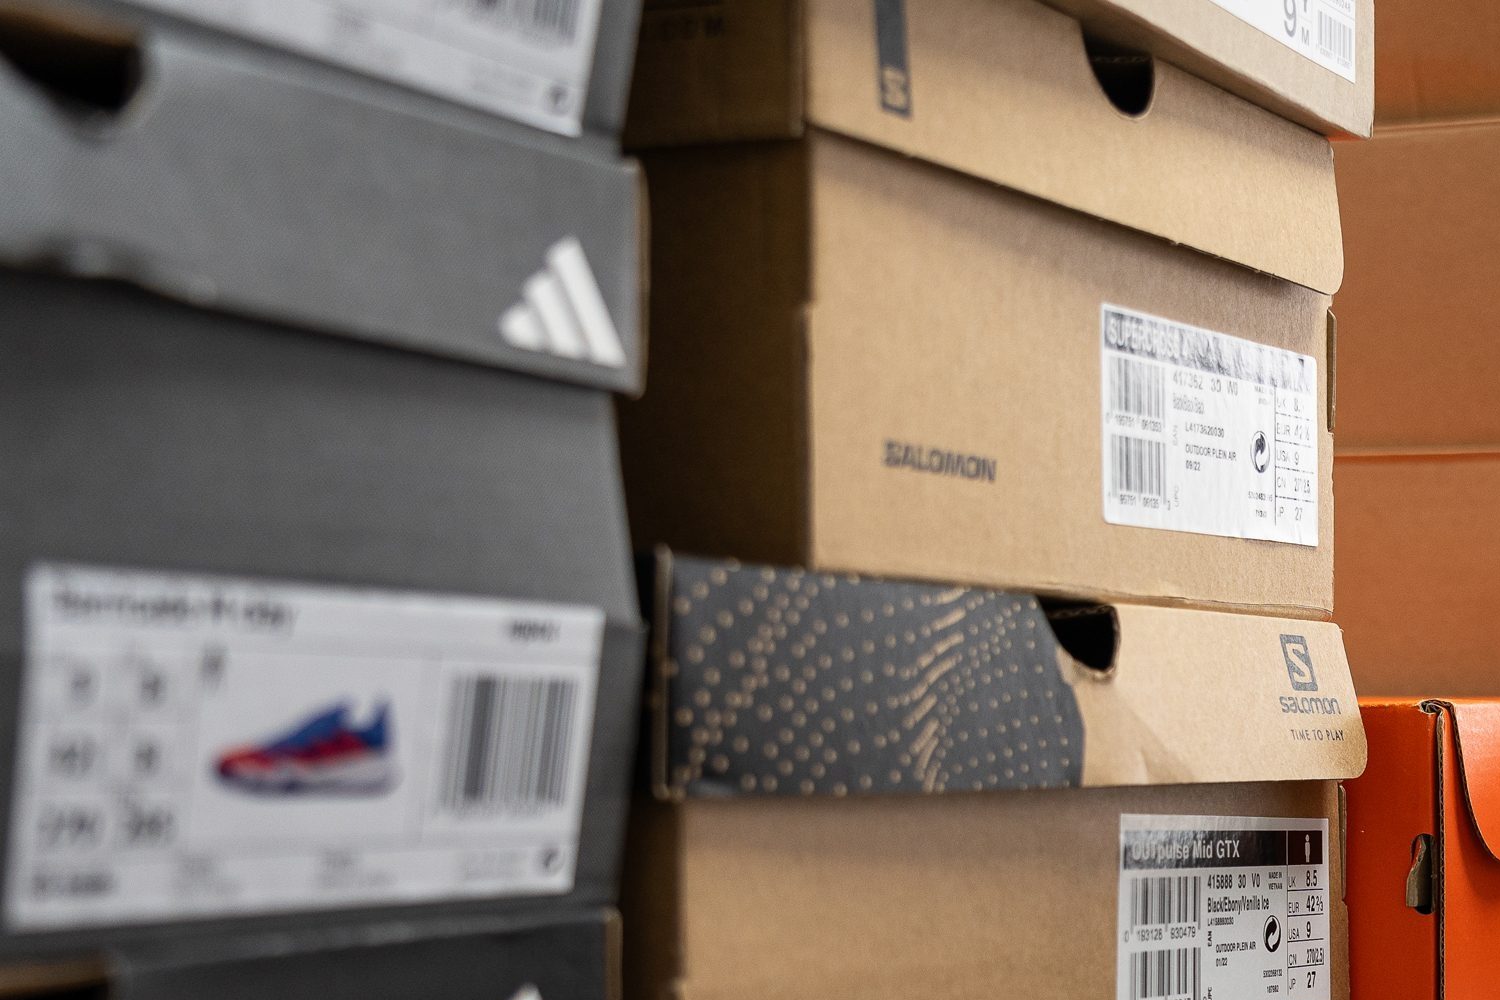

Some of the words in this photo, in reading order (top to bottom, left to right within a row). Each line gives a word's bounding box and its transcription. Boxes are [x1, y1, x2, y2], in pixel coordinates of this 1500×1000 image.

[884, 440, 997, 483] SALOMON
[1279, 696, 1342, 715] salomon
[1290, 729, 1311, 741] TIME
[1313, 729, 1324, 741] TO
[1326, 729, 1345, 741] PLAY
[1132, 840, 1189, 863] OUTpulse
[1193, 840, 1213, 859] Mid
[1216, 839, 1240, 858] GTX
[1207, 874, 1232, 889] 415888
[1238, 874, 1246, 888] 30
[1289, 876, 1296, 887] UK
[1306, 870, 1317, 886] 8.5
[1288, 901, 1300, 913] EUR
[1288, 928, 1300, 939] USA
[1306, 921, 1311, 938] 9
[1216, 942, 1236, 953] OUTDOOR
[1237, 941, 1249, 952] PLEIN
[1289, 953, 1297, 965] CN
[1289, 978, 1296, 990] JP
[1307, 971, 1316, 988] 27
